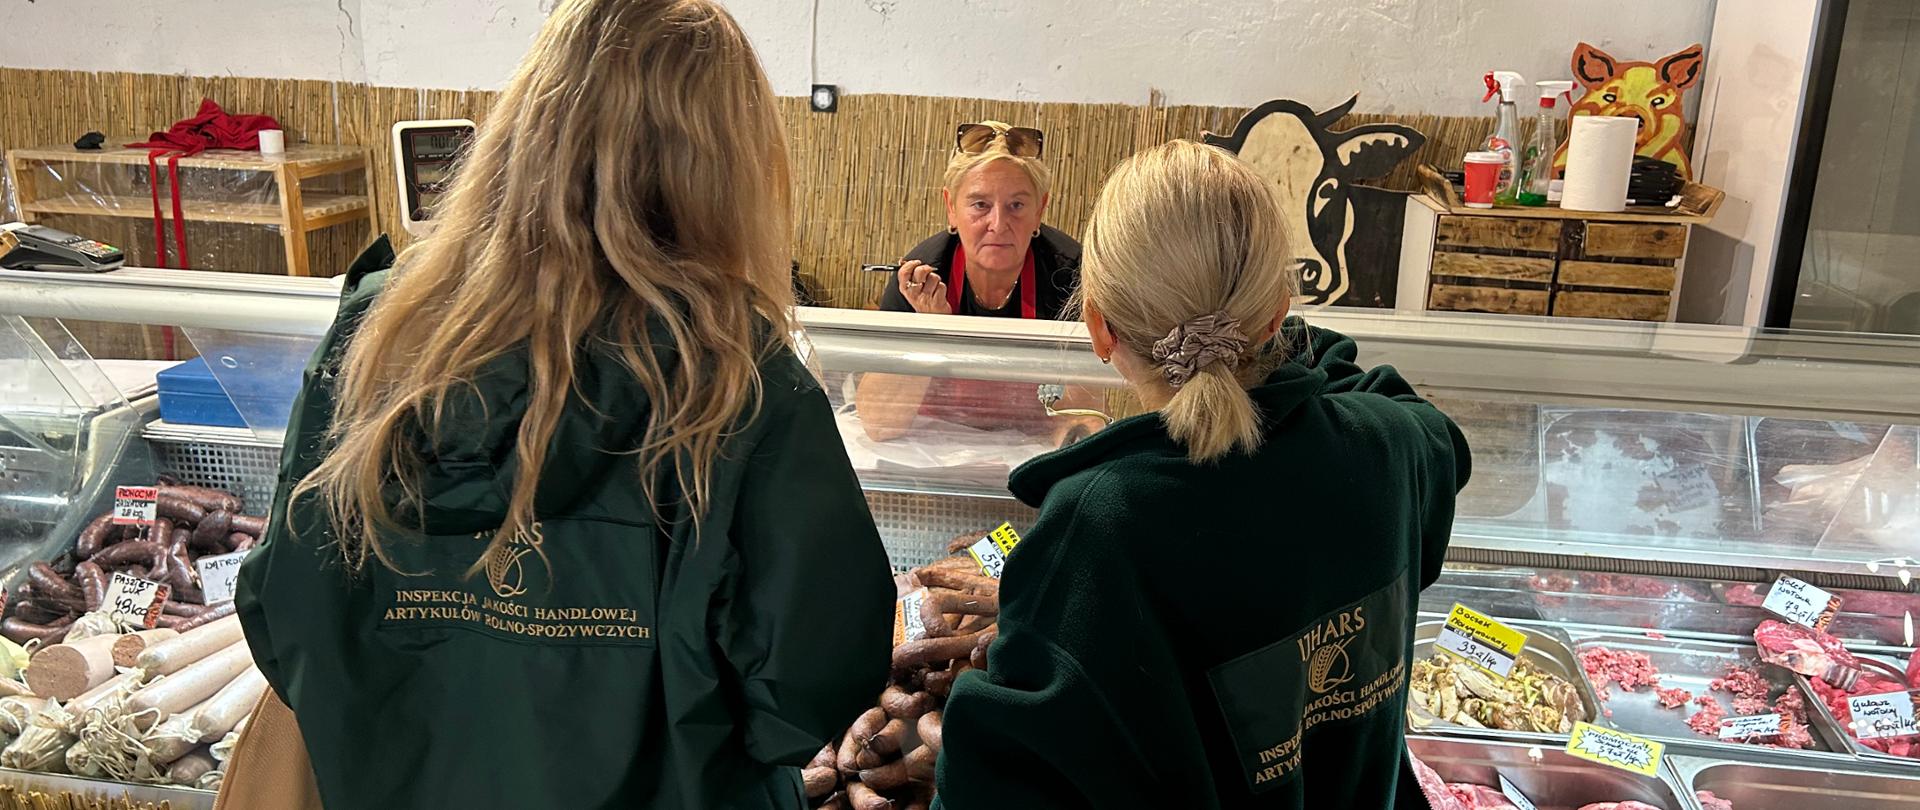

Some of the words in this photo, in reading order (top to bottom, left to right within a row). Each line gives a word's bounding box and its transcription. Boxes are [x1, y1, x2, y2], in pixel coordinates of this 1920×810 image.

[114, 574, 155, 590] PASZTET
[384, 605, 481, 622] ARTYKUŁÓW
[484, 613, 650, 639] ROLNO-SPOŻYWCZYCH
[396, 590, 477, 605] INSPEKCJA
[482, 596, 528, 617] JAKOŚCI
[534, 607, 637, 622] HANDLOWEJ
[1297, 606, 1366, 662] IJHARS
[1303, 689, 1356, 719] JAKOŚCI
